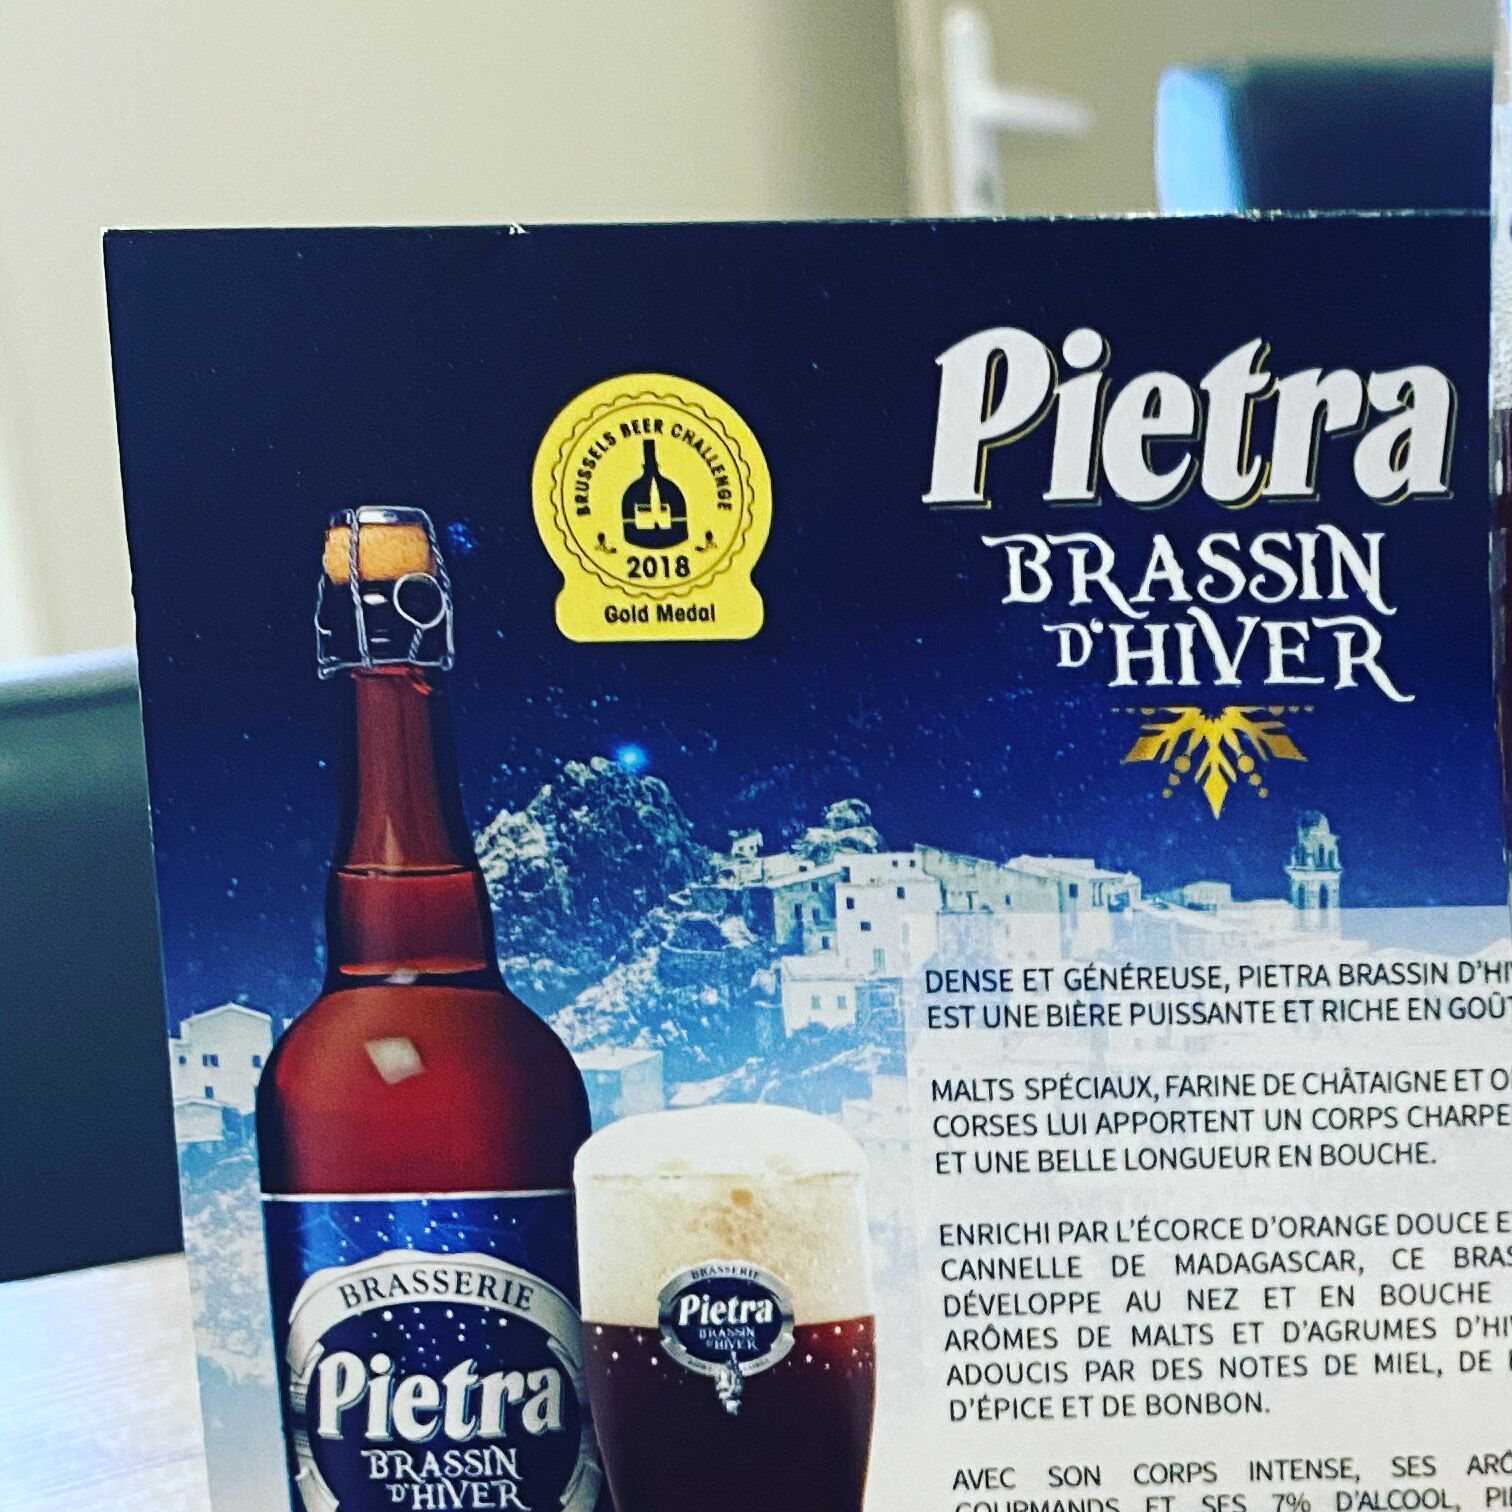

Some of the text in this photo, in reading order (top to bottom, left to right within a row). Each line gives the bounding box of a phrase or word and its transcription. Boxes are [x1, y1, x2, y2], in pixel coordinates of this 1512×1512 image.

[922, 327, 1457, 509] Pietra
[574, 418, 732, 517] BRUSSELS BEER CHALLENGE
[626, 555, 691, 578] 2018
[982, 523, 1397, 617] BRASSIN
[604, 603, 716, 624] Gold Medal
[1043, 606, 1415, 703] D'HIVER
[925, 961, 1449, 994] DENSE ET GÉNÉREUSE, PIETRA BRASSIN
[927, 996, 1442, 1030] EST UNE BIÈRE PUISSANTE ET RICHE EN
[931, 1066, 1485, 1104] MALTS SPÉCIAUX, FARINE DE CHÂTAIGNE ET
[932, 1105, 1399, 1139] CORSES LUI APPORTENT UN CORPS
[935, 1141, 1437, 1175] ET UNE BELLE LONGUEUR EN BOUCHE.
[939, 1221, 1050, 1248] ENRICHI
[1058, 1220, 1109, 1244] PAR
[1116, 1214, 1245, 1243] L'ÉCORCE
[1251, 1213, 1390, 1240] D'ORANGE
[1396, 1210, 1490, 1236] DOUCE
[940, 1246, 1425, 1282] CANNELLE DE MADAGASCAR, CE
[339, 1269, 534, 1311] BRASSERIE
[943, 1288, 1102, 1318] DÉVELOPPE
[1125, 1289, 1162, 1314] AU
[1186, 1287, 1240, 1312] NEZ
[1263, 1285, 1296, 1310] ET
[1320, 1284, 1355, 1308] EN
[1380, 1280, 1492, 1307] BOUCHE
[678, 1293, 774, 1326] Pietra
[944, 1323, 1059, 1352] ARÔMES
[1077, 1325, 1112, 1350] DE
[1131, 1322, 1214, 1348] MALTS
[1232, 1321, 1265, 1345] ET
[1283, 1316, 1437, 1344] D'AGRUMES
[946, 1360, 1069, 1387] ADOUCIS
[1085, 1358, 1136, 1383] PAR
[1151, 1357, 1204, 1382] DES
[1219, 1354, 1309, 1380] NOTES
[1324, 1353, 1358, 1377] DE
[1374, 1351, 1443, 1379] MIEL,
[1459, 1349, 1492, 1374] DE
[317, 1350, 564, 1442] Pietra
[949, 1391, 1270, 1423] D'ÉPICE ET DE BONBON.
[361, 1445, 522, 1481] BRASSIN
[952, 1466, 1017, 1491] AVEC
[1048, 1464, 1102, 1489] SON
[1133, 1460, 1218, 1486] CORPS
[1249, 1456, 1361, 1484] INTENSE,
[1391, 1455, 1437, 1478] SES
[387, 1476, 531, 1512] D'HIVER
[1335, 1487, 1462, 1512] D'ALCOOL,
